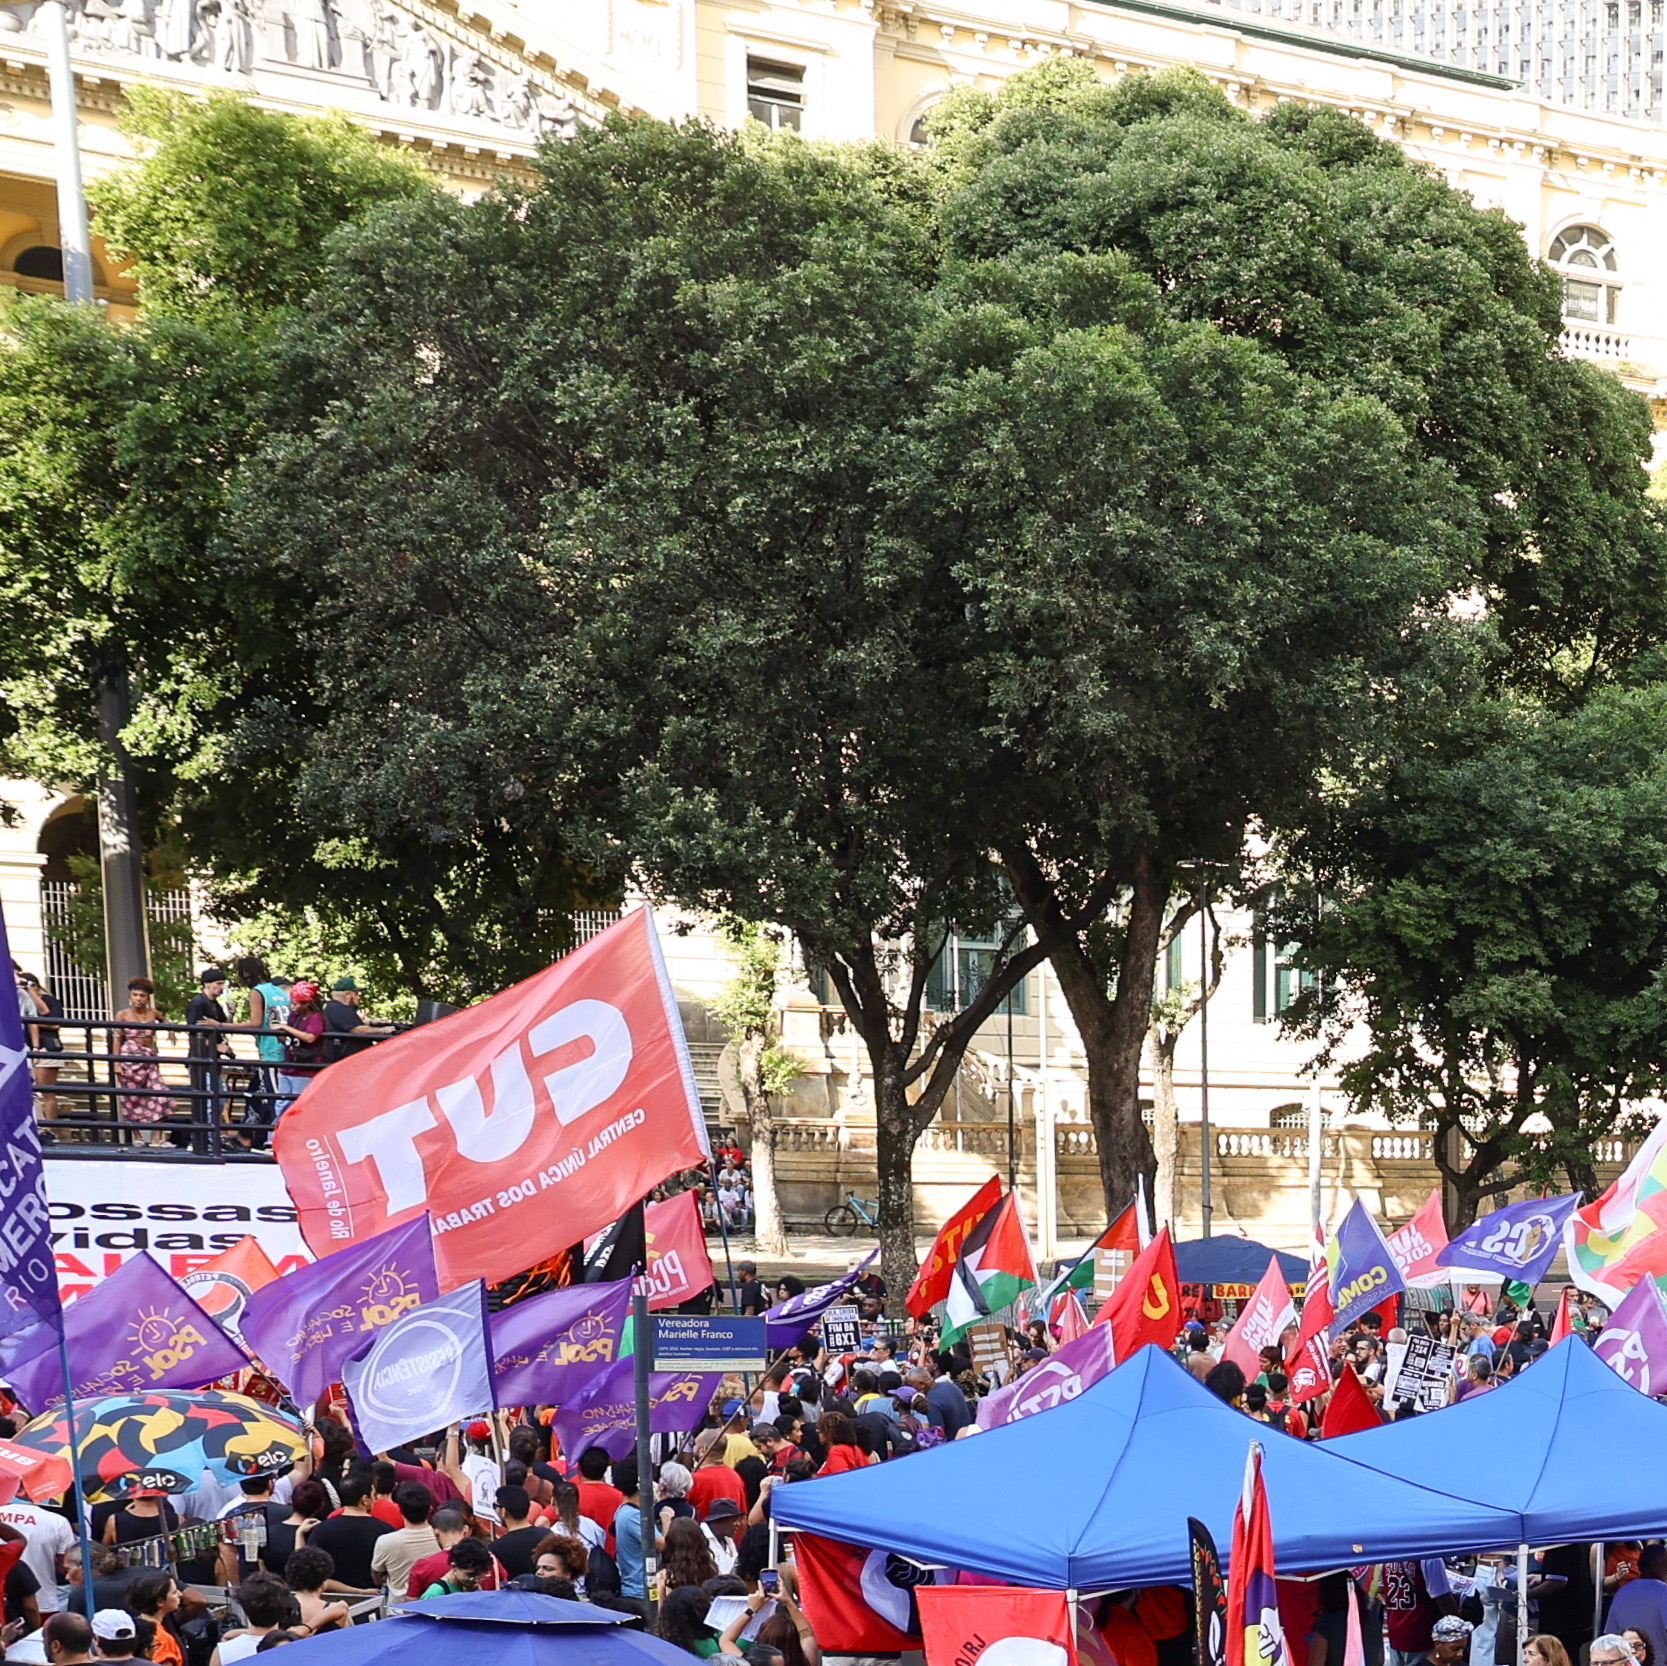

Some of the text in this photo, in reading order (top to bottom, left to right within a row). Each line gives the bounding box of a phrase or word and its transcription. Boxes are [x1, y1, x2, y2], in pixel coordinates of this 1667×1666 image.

[658, 1318, 709, 1328] Vereadora
[828, 1322, 855, 1333] FIM DA
[658, 1330, 733, 1339] Marielle Franco
[835, 1333, 856, 1346] 6X1
[257, 1449, 288, 1467] elo
[141, 1473, 176, 1489] elo
[1387, 1575, 1417, 1611] 23
